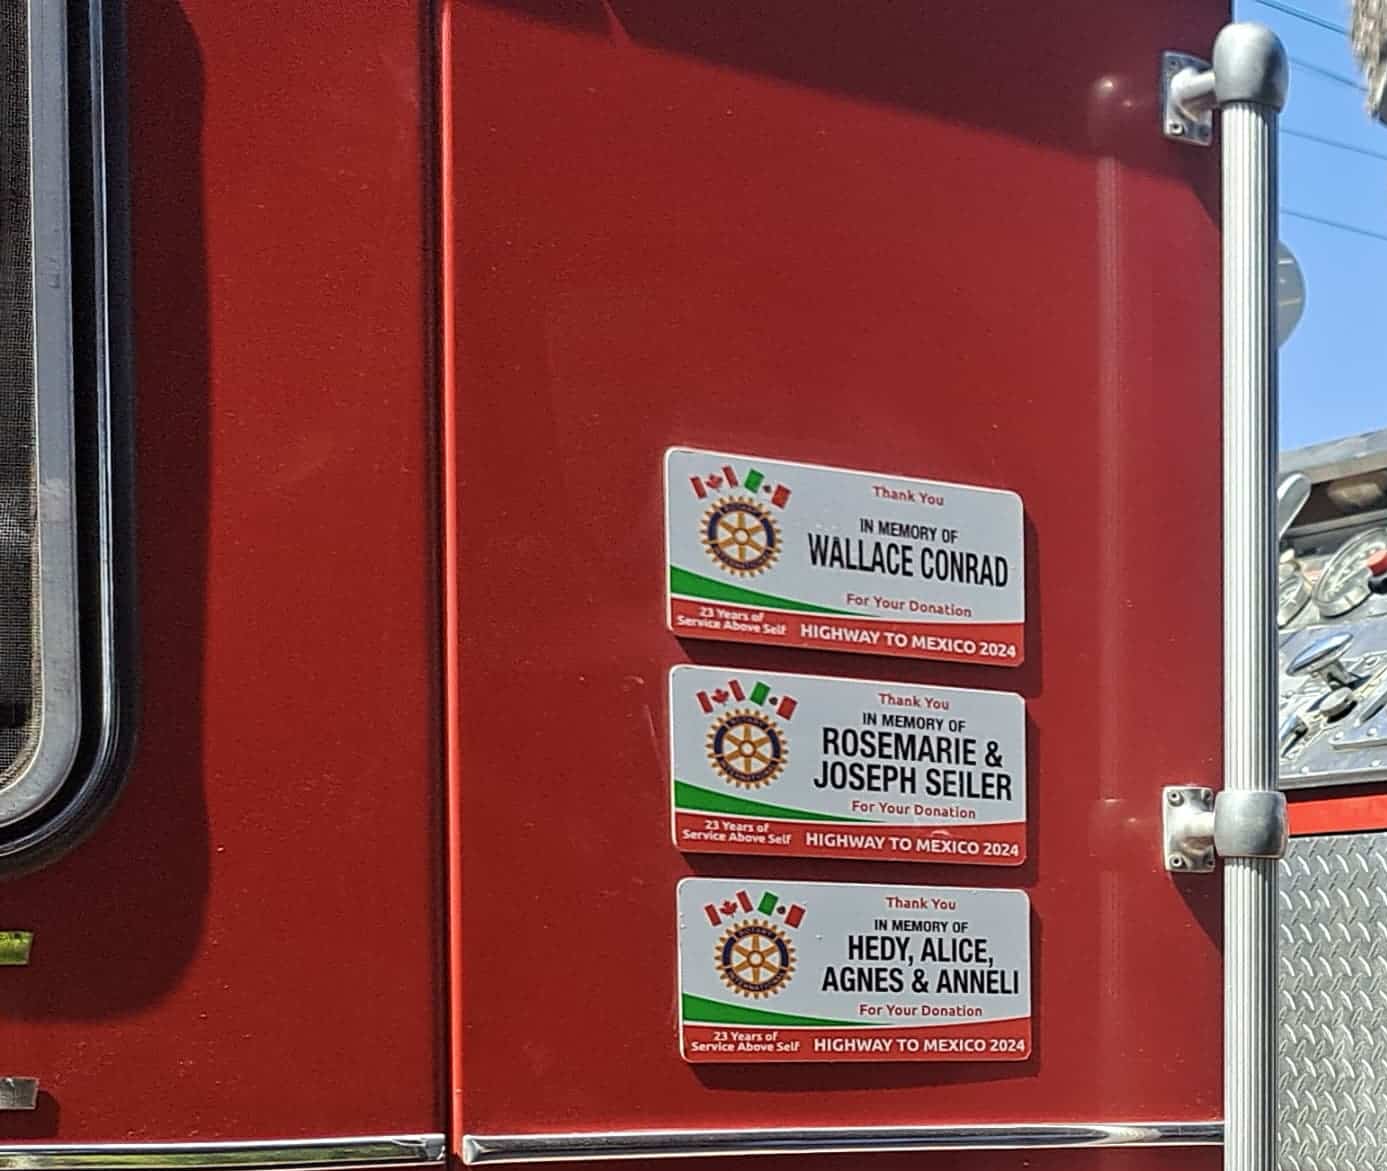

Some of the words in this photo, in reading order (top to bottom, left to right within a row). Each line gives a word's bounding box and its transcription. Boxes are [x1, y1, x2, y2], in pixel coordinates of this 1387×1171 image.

[873, 486, 915, 505] Thank
[918, 491, 944, 506] You
[860, 518, 875, 535] IN
[879, 520, 937, 543] MEMORY
[942, 528, 958, 543] OF
[808, 533, 914, 576] WALLACE
[921, 547, 1008, 587] CONRAD
[699, 606, 717, 618] 23
[720, 608, 747, 621] Years
[749, 611, 764, 622] of
[846, 594, 868, 607] For
[873, 596, 904, 611] Your
[909, 599, 972, 617] Donation
[677, 615, 720, 630] Service
[724, 619, 759, 633] Above
[762, 623, 786, 636] Self
[801, 624, 880, 644] HIGHWAY
[884, 631, 907, 647] TO
[912, 634, 976, 654] MEXICO
[979, 642, 1016, 658] 2024
[878, 693, 920, 708] Thank
[925, 697, 949, 710] You
[863, 712, 876, 725] IN
[882, 715, 942, 731] MEMORY
[948, 719, 965, 732] OF
[822, 728, 976, 765] ROSEMARIE
[985, 742, 1003, 767] &
[814, 761, 916, 794] JOSEPH
[926, 770, 1012, 801] SEILER
[851, 800, 874, 812] For
[878, 802, 909, 817] Your
[914, 805, 976, 819] Donation
[705, 820, 723, 830] 23
[726, 822, 754, 832] Years
[756, 823, 769, 833] of
[683, 831, 726, 841] Service
[729, 832, 764, 843] Above
[768, 834, 791, 844] Self
[806, 831, 885, 848] HIGHWAY
[889, 835, 911, 850] TO
[916, 838, 979, 854] MEXICO
[984, 842, 1018, 856] 2024
[885, 897, 927, 910] Thank
[930, 898, 956, 911] You
[874, 919, 888, 931] IN
[892, 920, 948, 932] MEMORY
[953, 921, 968, 933] OF
[848, 936, 914, 966] HEDY,
[920, 938, 994, 968] ALICE,
[822, 967, 905, 992] AGNES
[912, 969, 929, 993] &
[936, 970, 1019, 994] ANNELI
[859, 1005, 882, 1016] For
[886, 1005, 918, 1017] Your
[922, 1005, 982, 1017] Donation
[692, 1041, 734, 1052] Service
[737, 1041, 773, 1052] Above
[776, 1040, 800, 1051] Self
[714, 1031, 727, 1041] 23
[731, 1031, 761, 1042] Years
[764, 1031, 778, 1041] of
[814, 1038, 893, 1052] HIGHWAY
[897, 1038, 920, 1051] TO
[923, 1038, 985, 1052] MEXICO
[990, 1038, 1024, 1052] 2024
